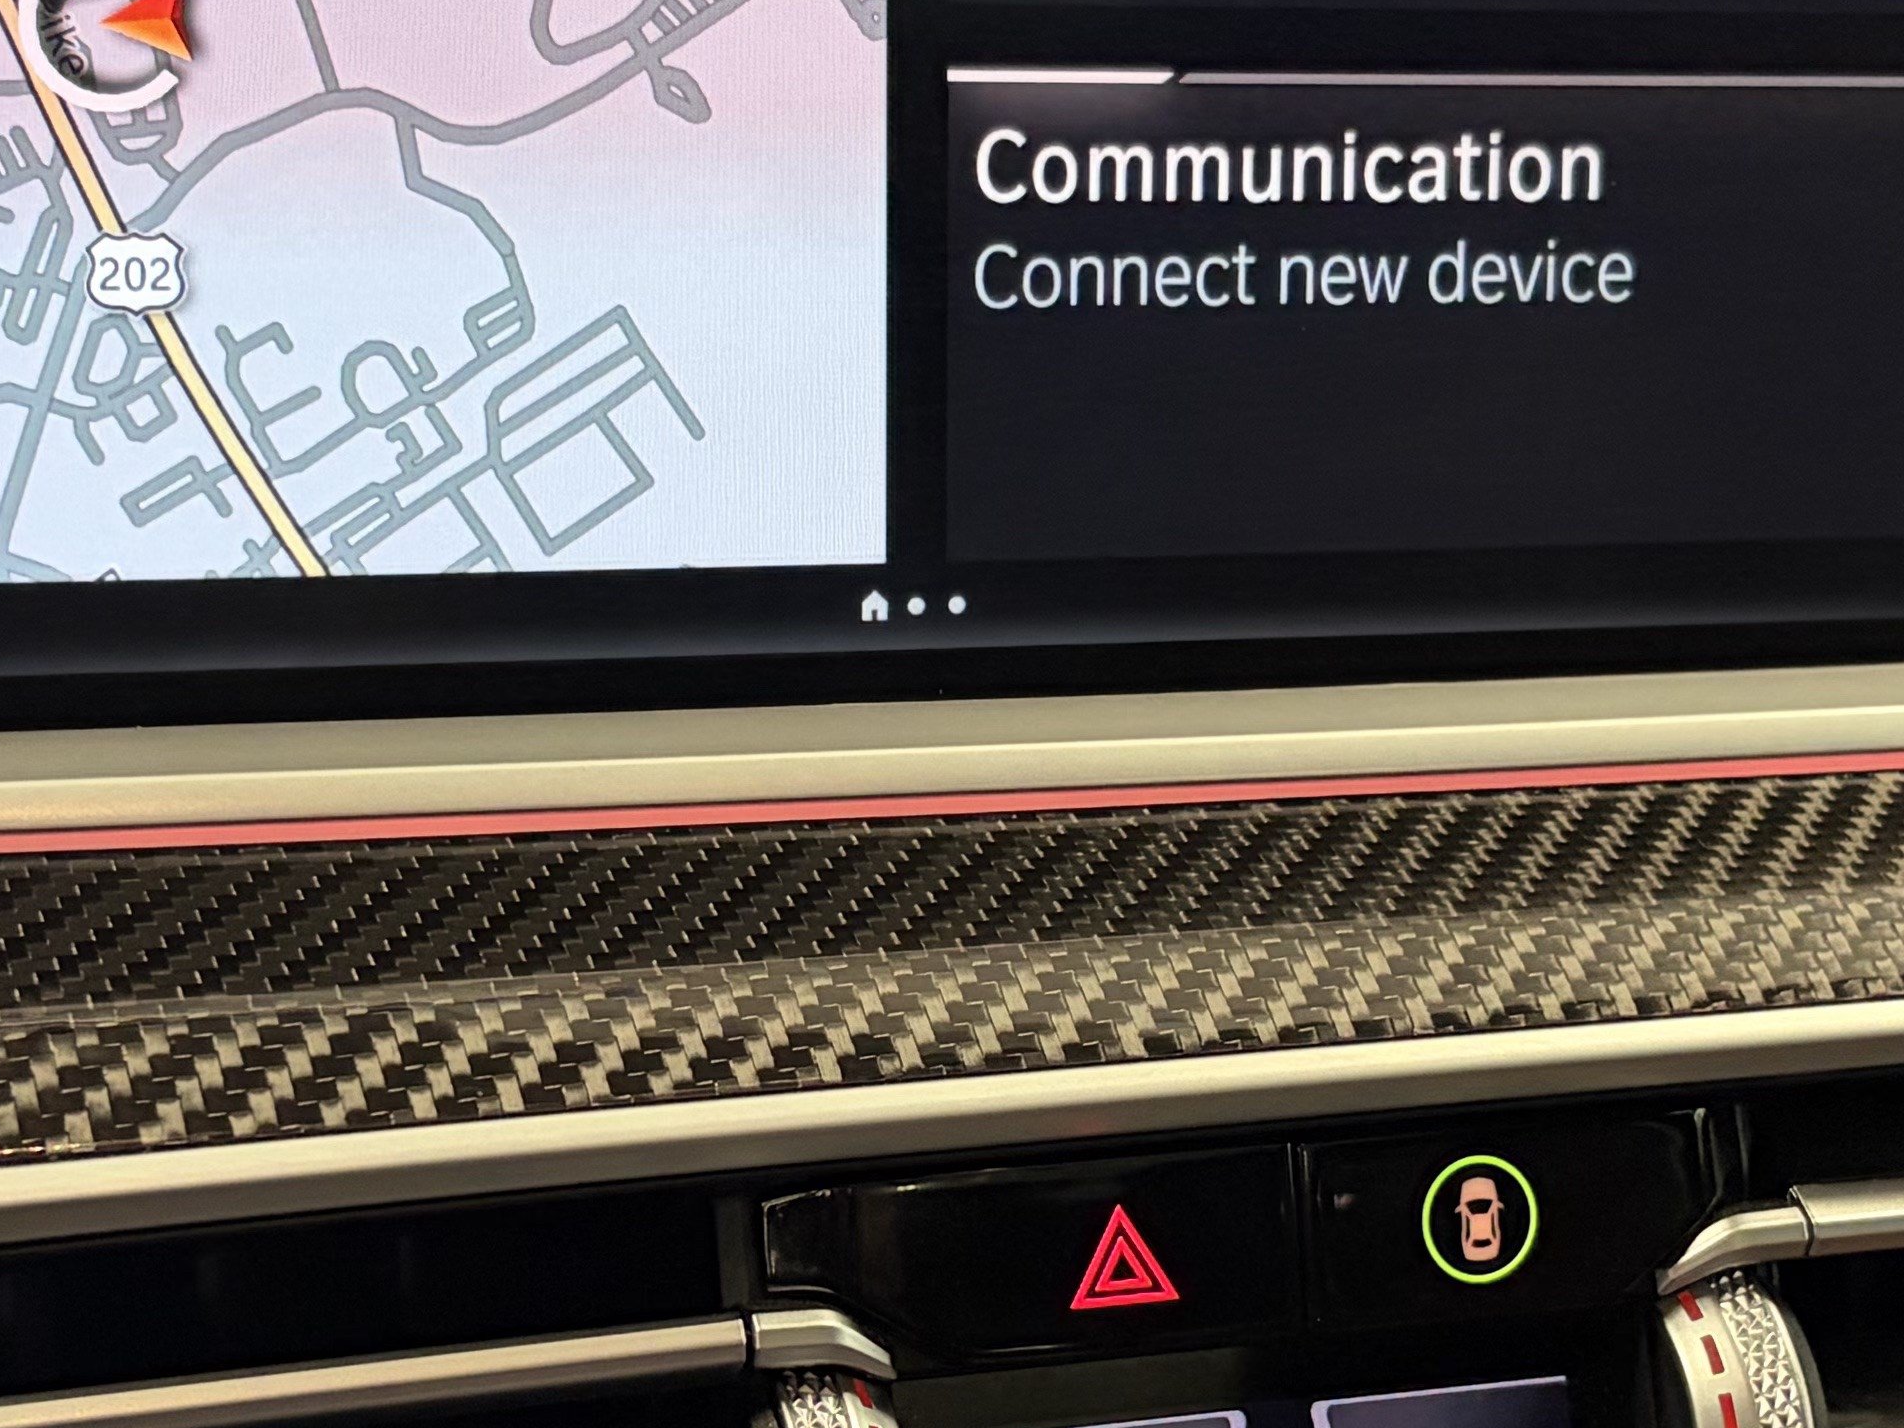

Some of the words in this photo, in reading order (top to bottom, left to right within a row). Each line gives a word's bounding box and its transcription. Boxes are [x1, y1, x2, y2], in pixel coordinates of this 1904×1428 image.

[976, 127, 1601, 204] Communication
[99, 256, 171, 292] 202
[974, 243, 1256, 310] Connect
[1279, 254, 1409, 306] new
[1428, 239, 1634, 304] device
